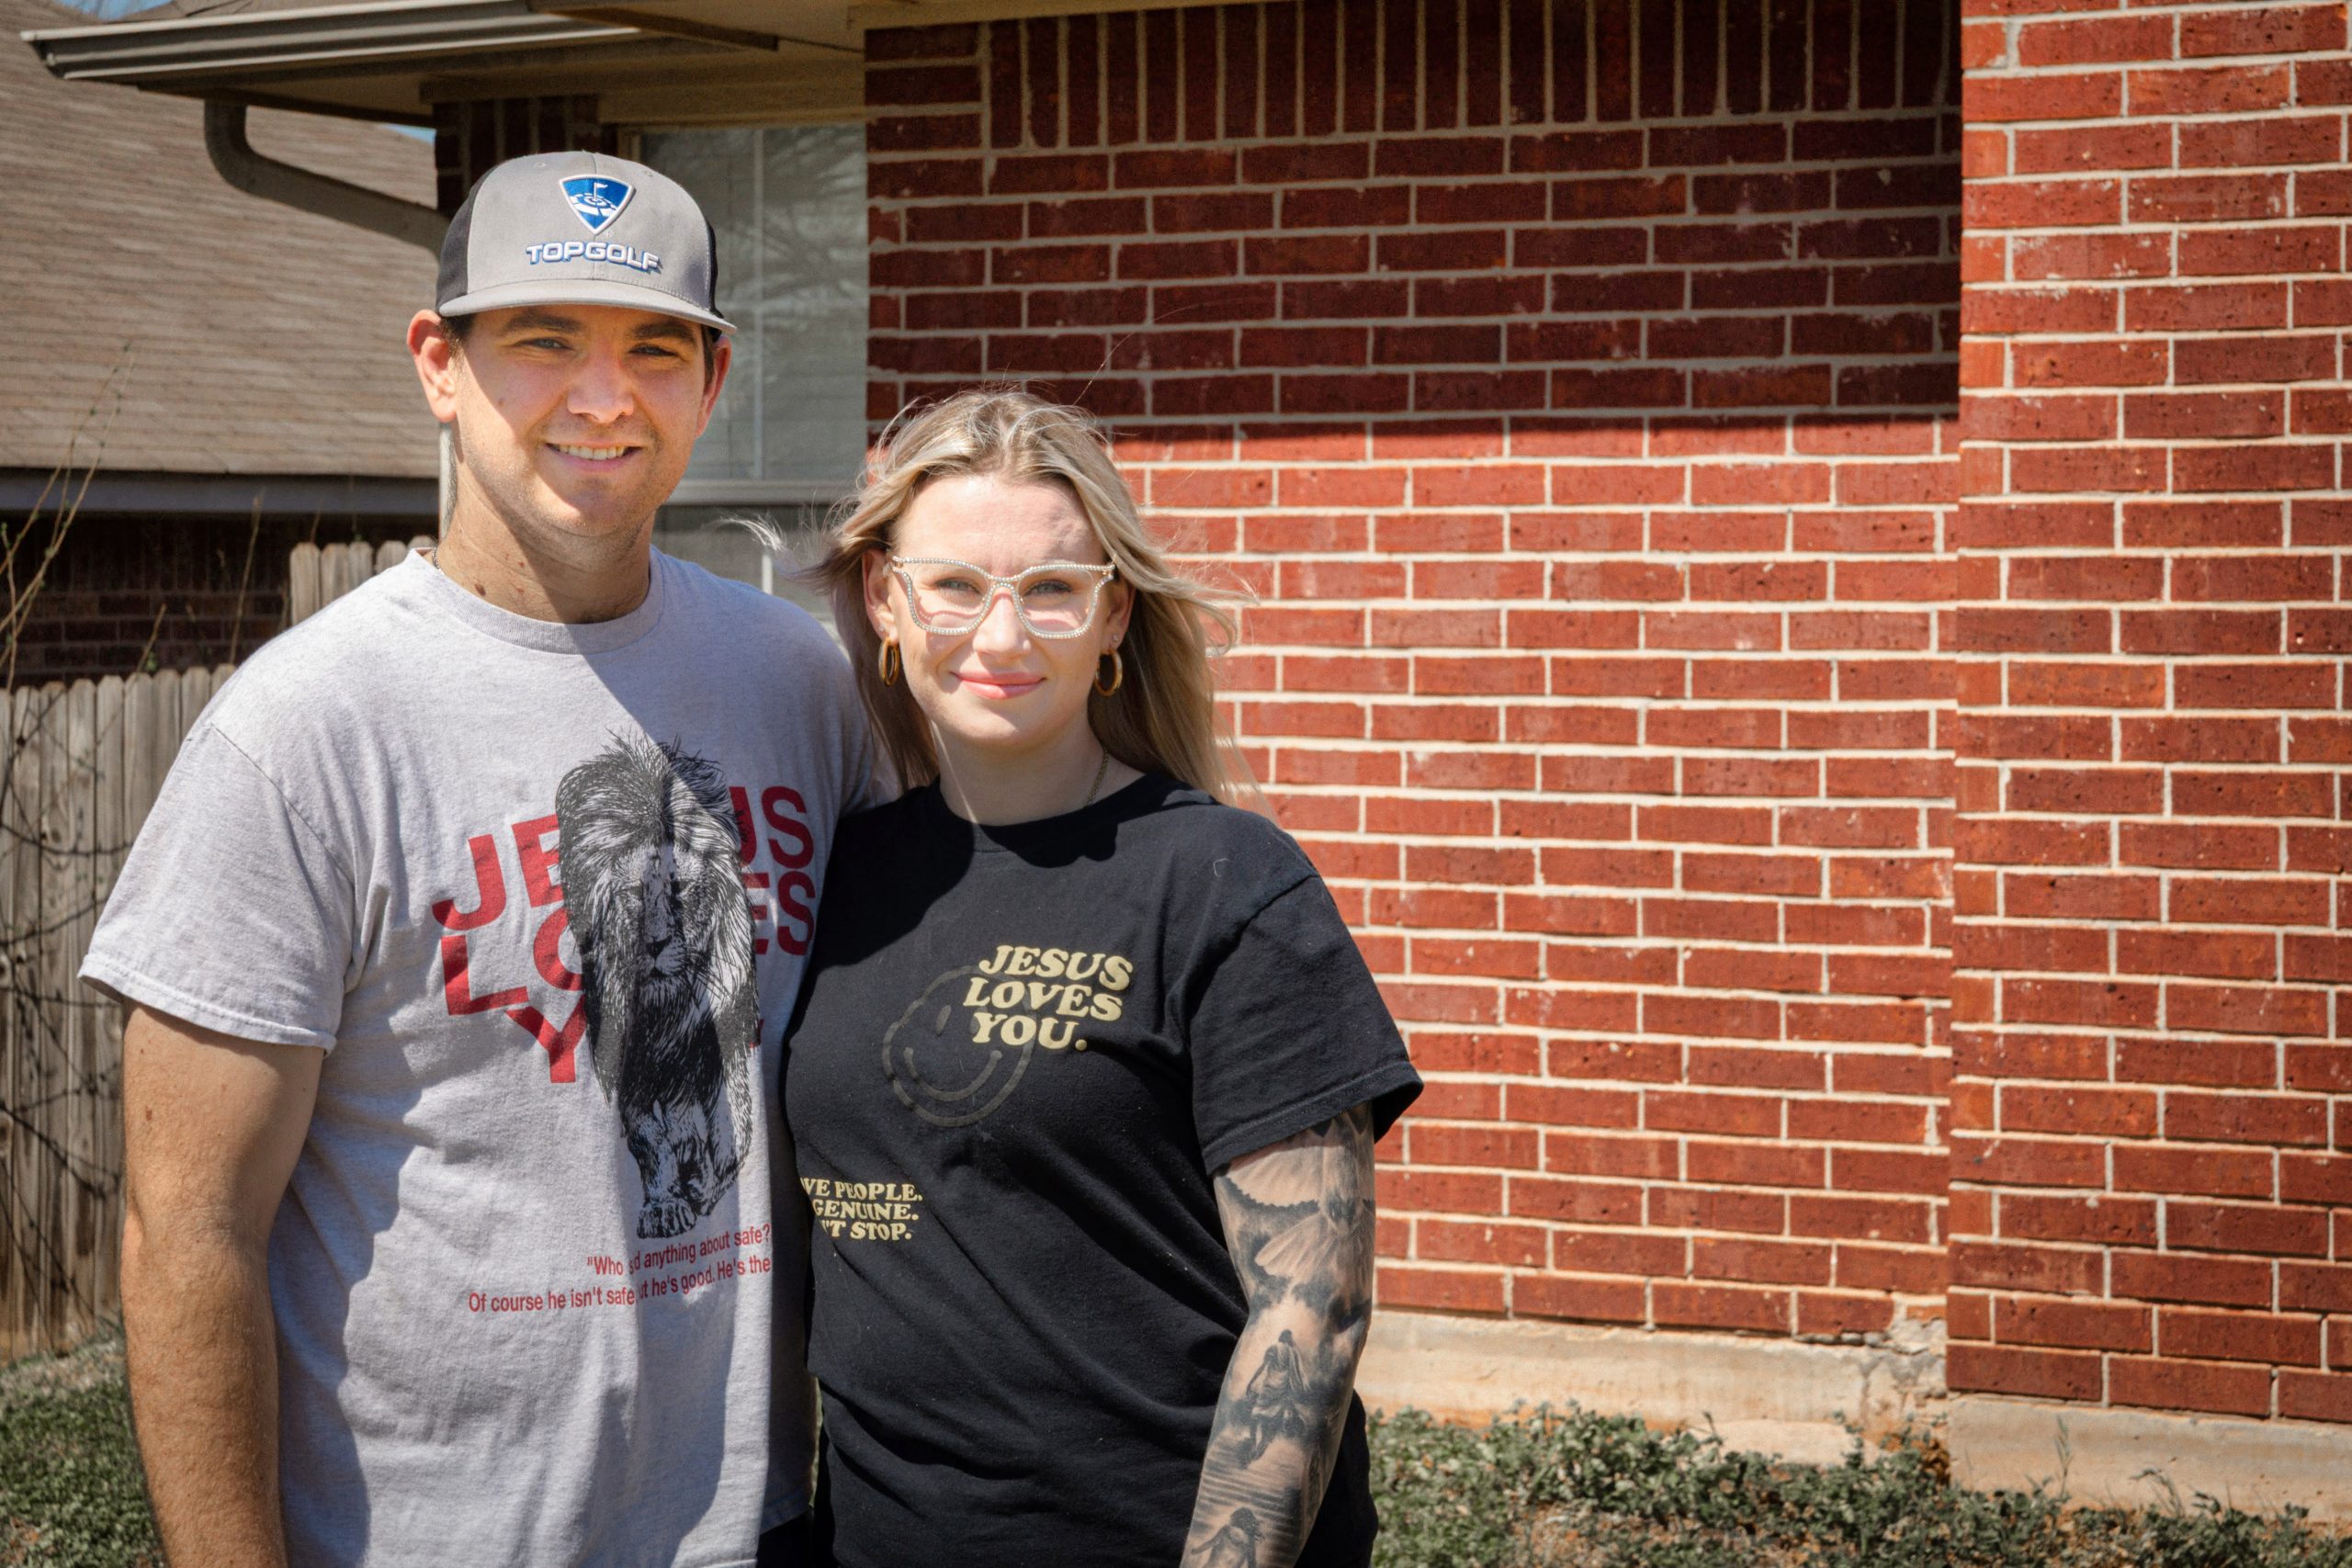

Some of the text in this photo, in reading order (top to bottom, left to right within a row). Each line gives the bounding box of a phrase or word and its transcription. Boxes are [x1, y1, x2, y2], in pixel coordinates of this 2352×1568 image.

[526, 241, 663, 274] TOPGOLF
[978, 944, 1134, 991] JESUS
[963, 976, 1123, 1021] LOVES
[972, 1011, 1088, 1051] YOU.
[812, 1199, 920, 1221] GENUINE.
[834, 1180, 923, 1201] PEOPLE.
[587, 1256, 624, 1276] "Who
[644, 1241, 696, 1269] anything
[699, 1231, 730, 1257] about
[733, 1223, 771, 1247] safe?
[850, 1222, 912, 1241] STOP.
[469, 1292, 486, 1313] Of
[491, 1294, 543, 1312] course
[548, 1291, 566, 1309] he
[571, 1286, 602, 1308] isn't
[651, 1275, 679, 1297] he's
[681, 1265, 716, 1294] good.
[717, 1258, 745, 1280] He's
[749, 1255, 771, 1273] the
